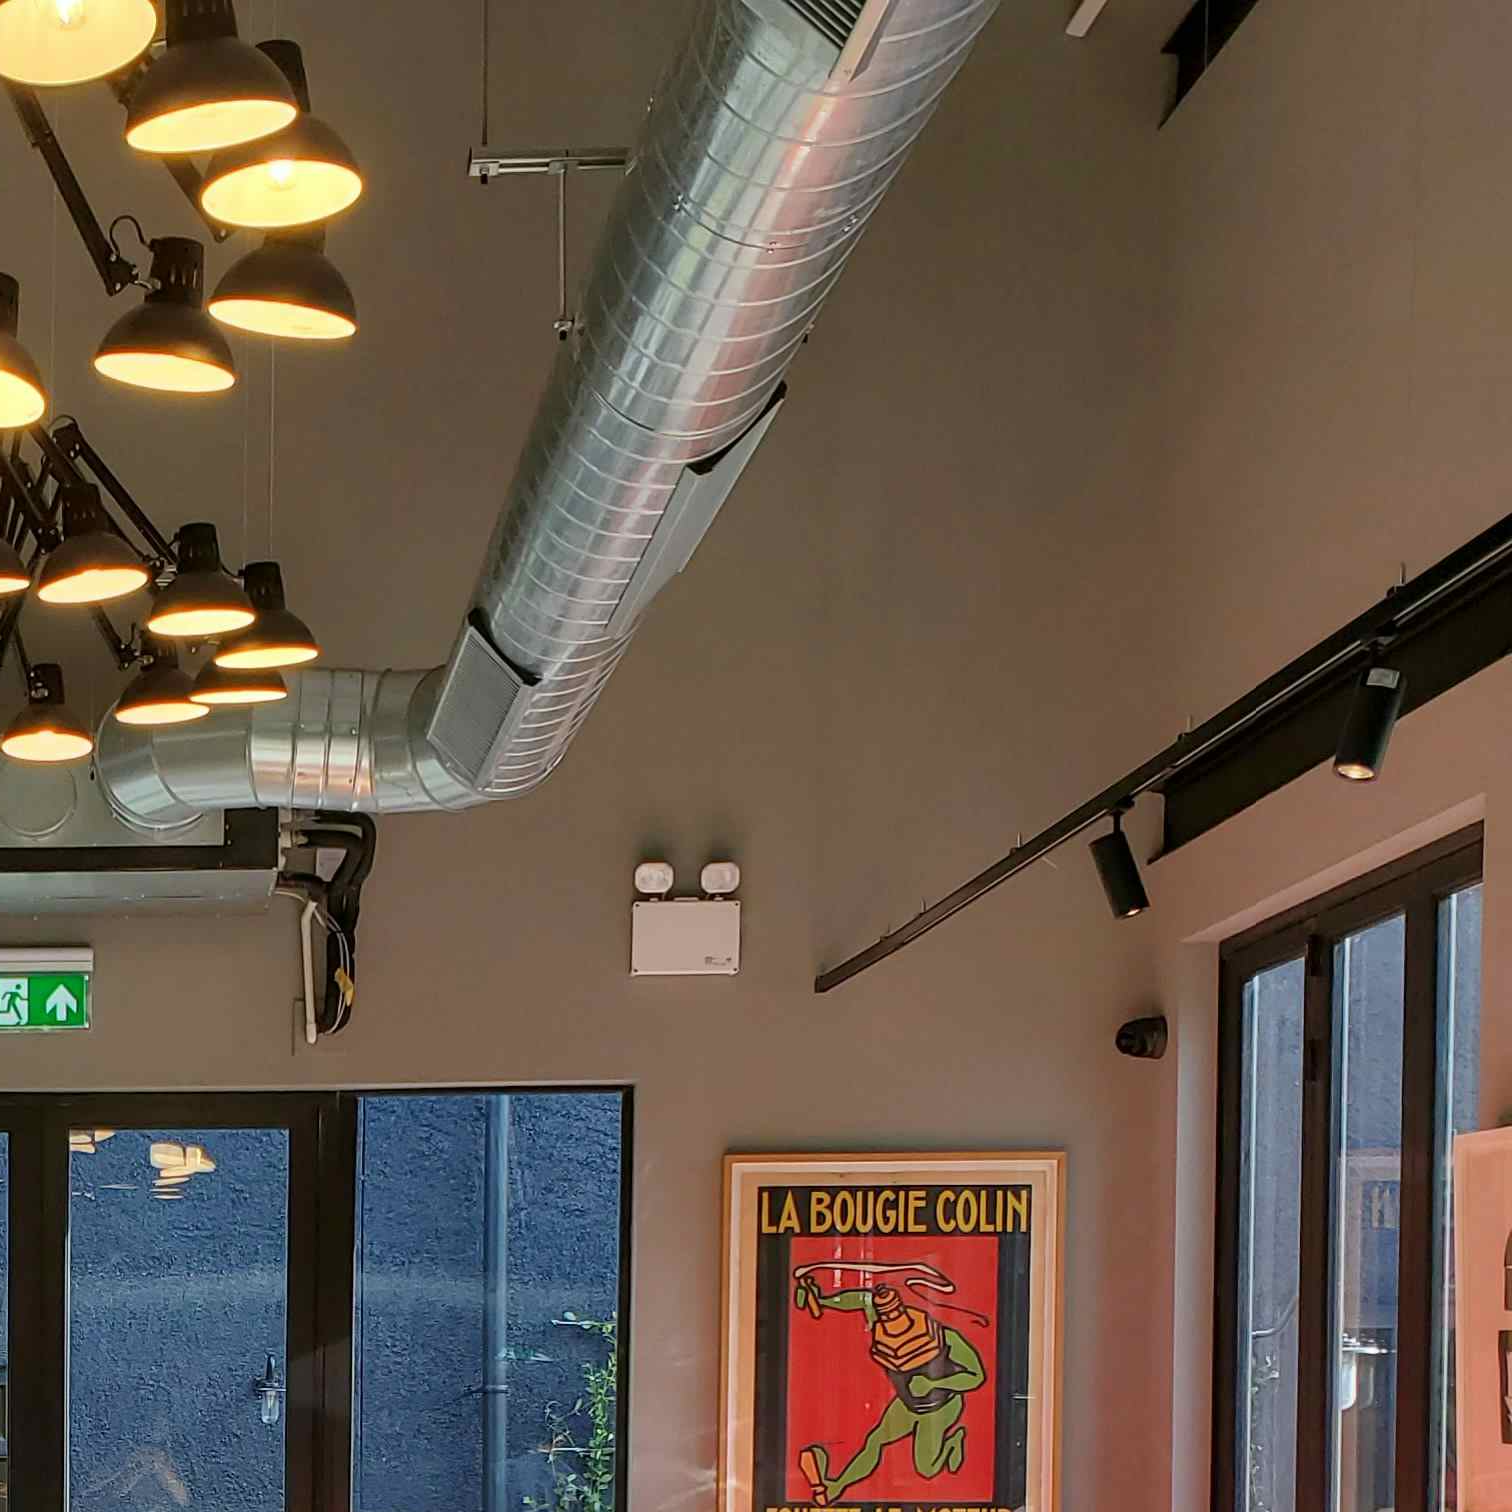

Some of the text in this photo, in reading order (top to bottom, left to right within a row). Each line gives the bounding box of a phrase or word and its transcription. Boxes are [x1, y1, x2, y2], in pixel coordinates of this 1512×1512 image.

[761, 1189, 1028, 1234] LA BOUGIE COLIN
